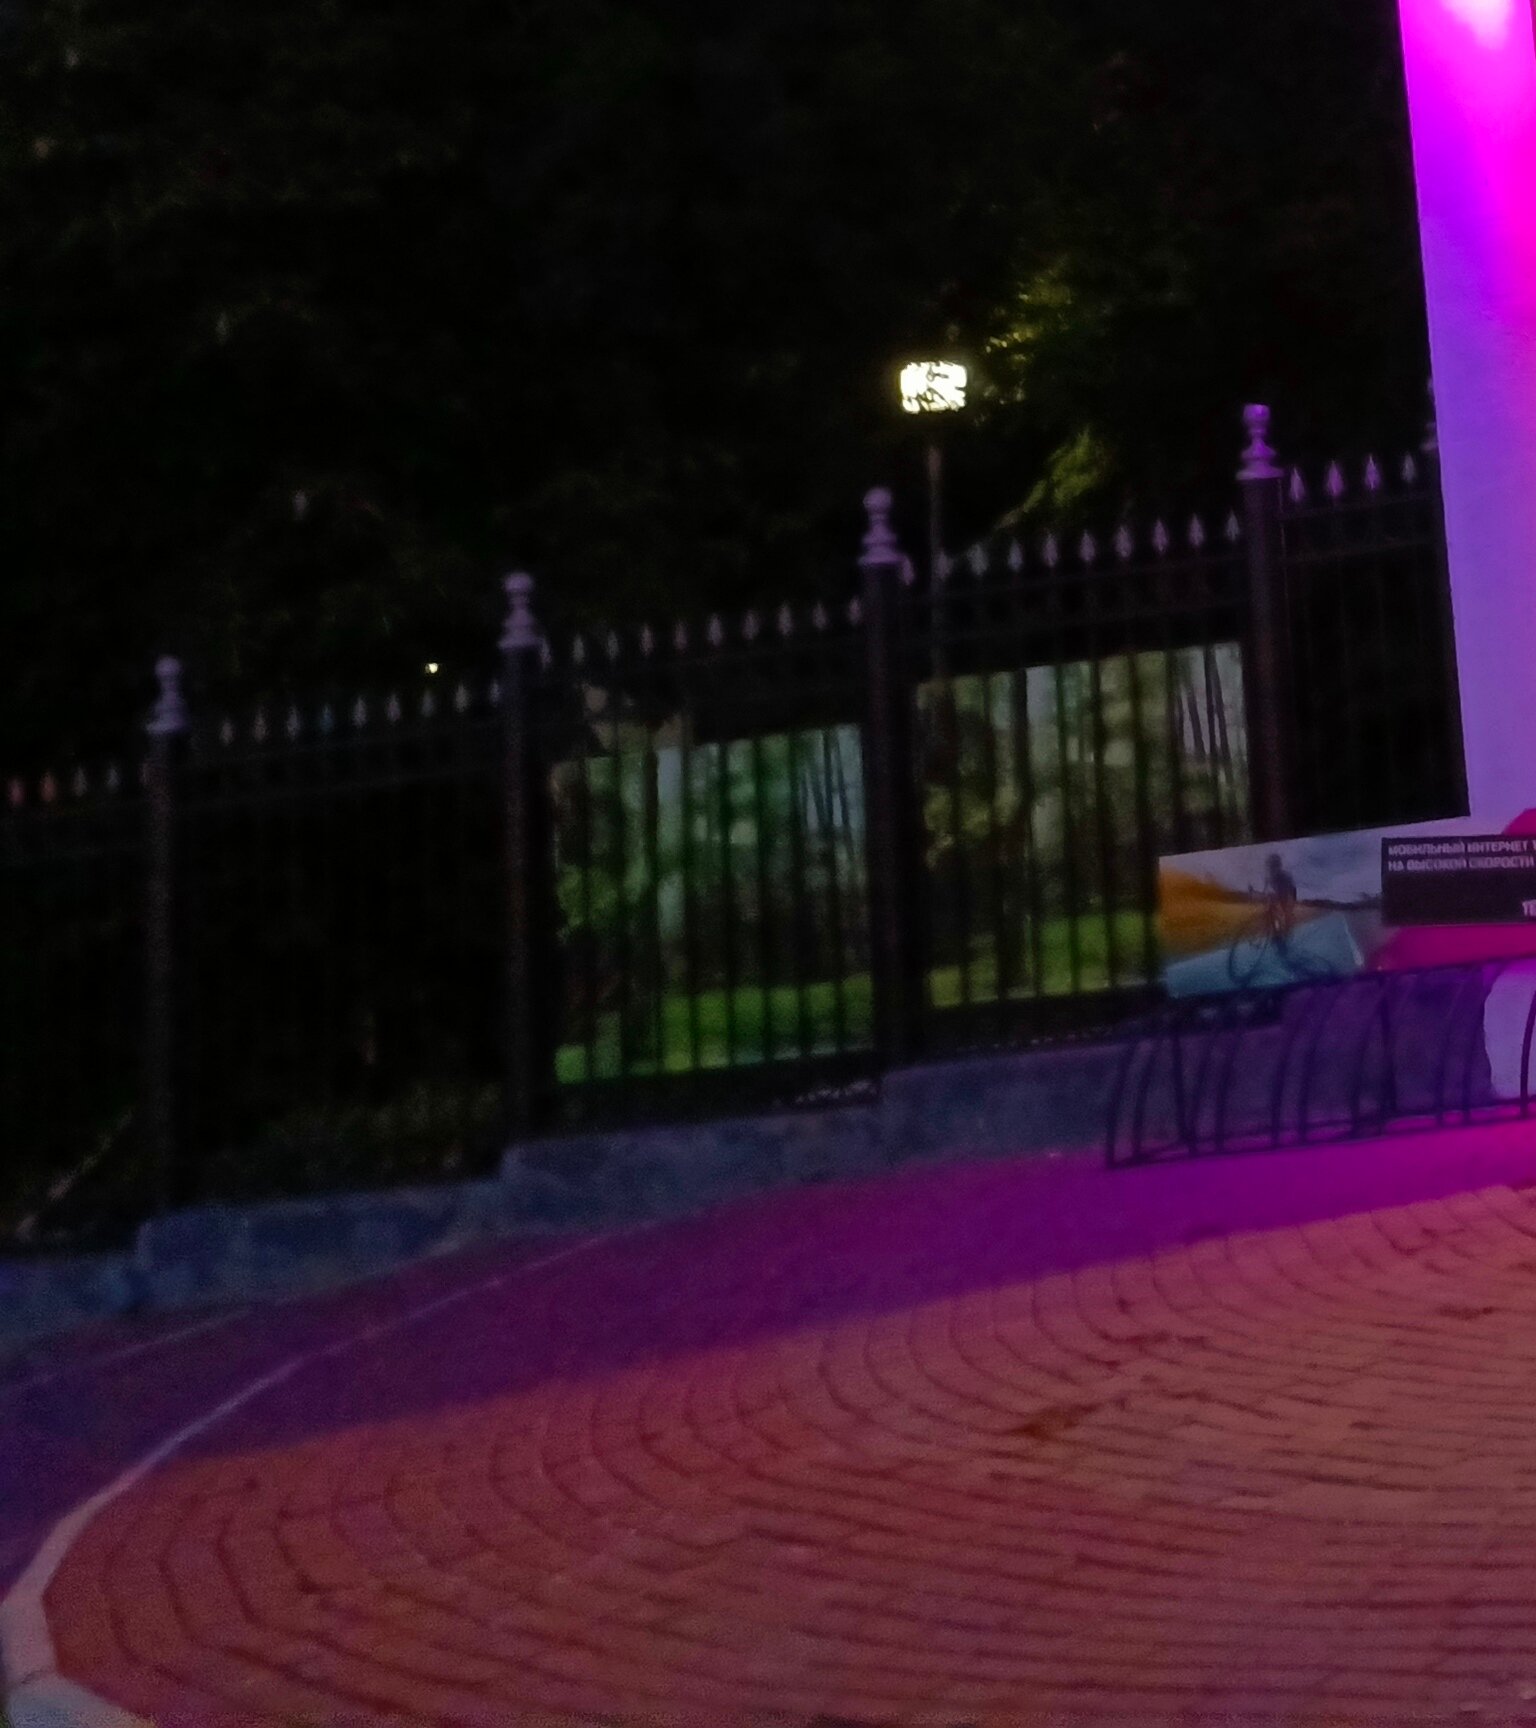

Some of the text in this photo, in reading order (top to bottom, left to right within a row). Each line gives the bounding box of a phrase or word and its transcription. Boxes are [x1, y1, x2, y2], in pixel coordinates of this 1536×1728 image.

[1388, 841, 1465, 856] МОБИЛЬНЫЙ
[1467, 839, 1528, 853] ИНТЕРНЕТ
[1388, 855, 1535, 872] НА ВЫСОКОЙ СКОРОСТИ
